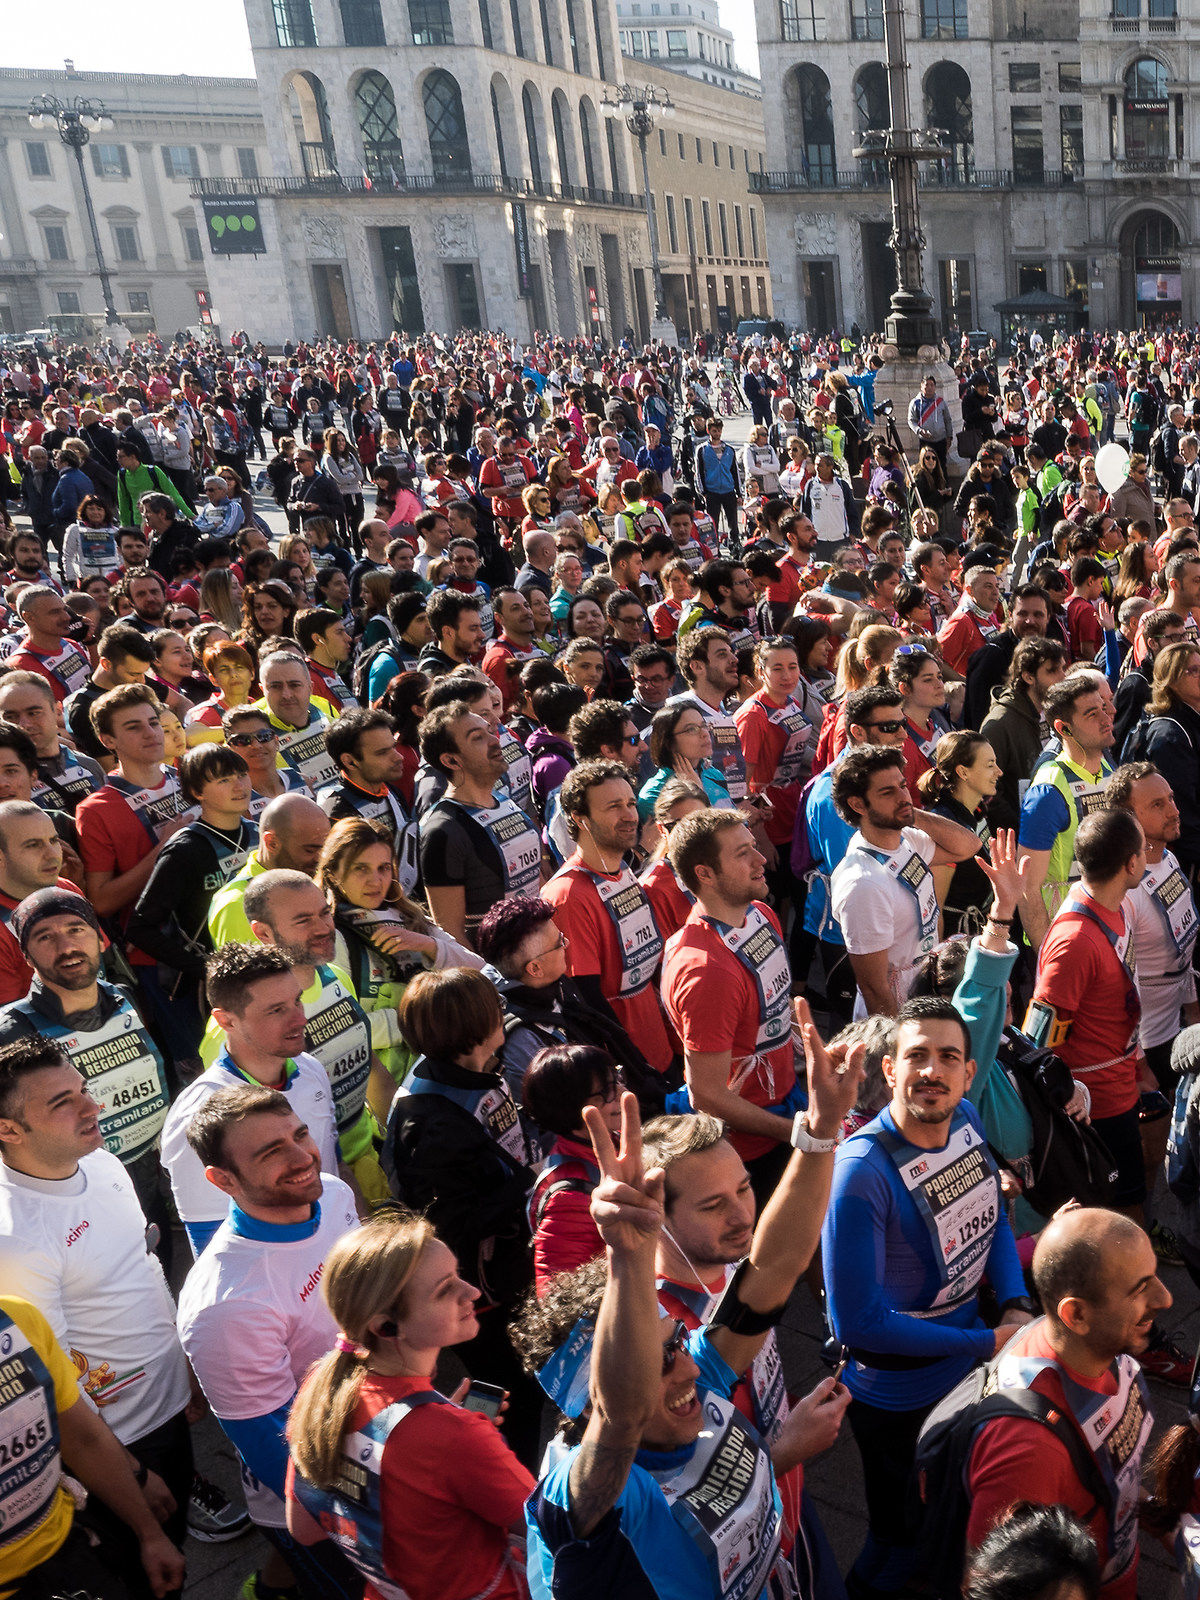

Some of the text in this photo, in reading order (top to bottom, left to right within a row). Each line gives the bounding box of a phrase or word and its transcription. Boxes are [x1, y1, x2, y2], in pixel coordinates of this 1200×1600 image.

[211, 215, 257, 238] 900
[518, 848, 538, 868] 7069
[635, 925, 652, 945] 7782
[627, 941, 662, 967] Stramilano
[303, 1001, 352, 1038] PARMIGIANO
[311, 1014, 354, 1046] REGGIANO
[72, 1033, 142, 1068] PARMIGIANO
[85, 1046, 141, 1077] REGGIANO
[333, 1045, 368, 1077] 42646
[112, 1078, 156, 1108] 48451
[332, 1065, 371, 1096] ramilano
[100, 1098, 165, 1134] tramilano
[925, 1150, 984, 1197] PARMIGIANO
[937, 1166, 985, 1207] REGGIANO
[959, 1205, 995, 1246] 12968
